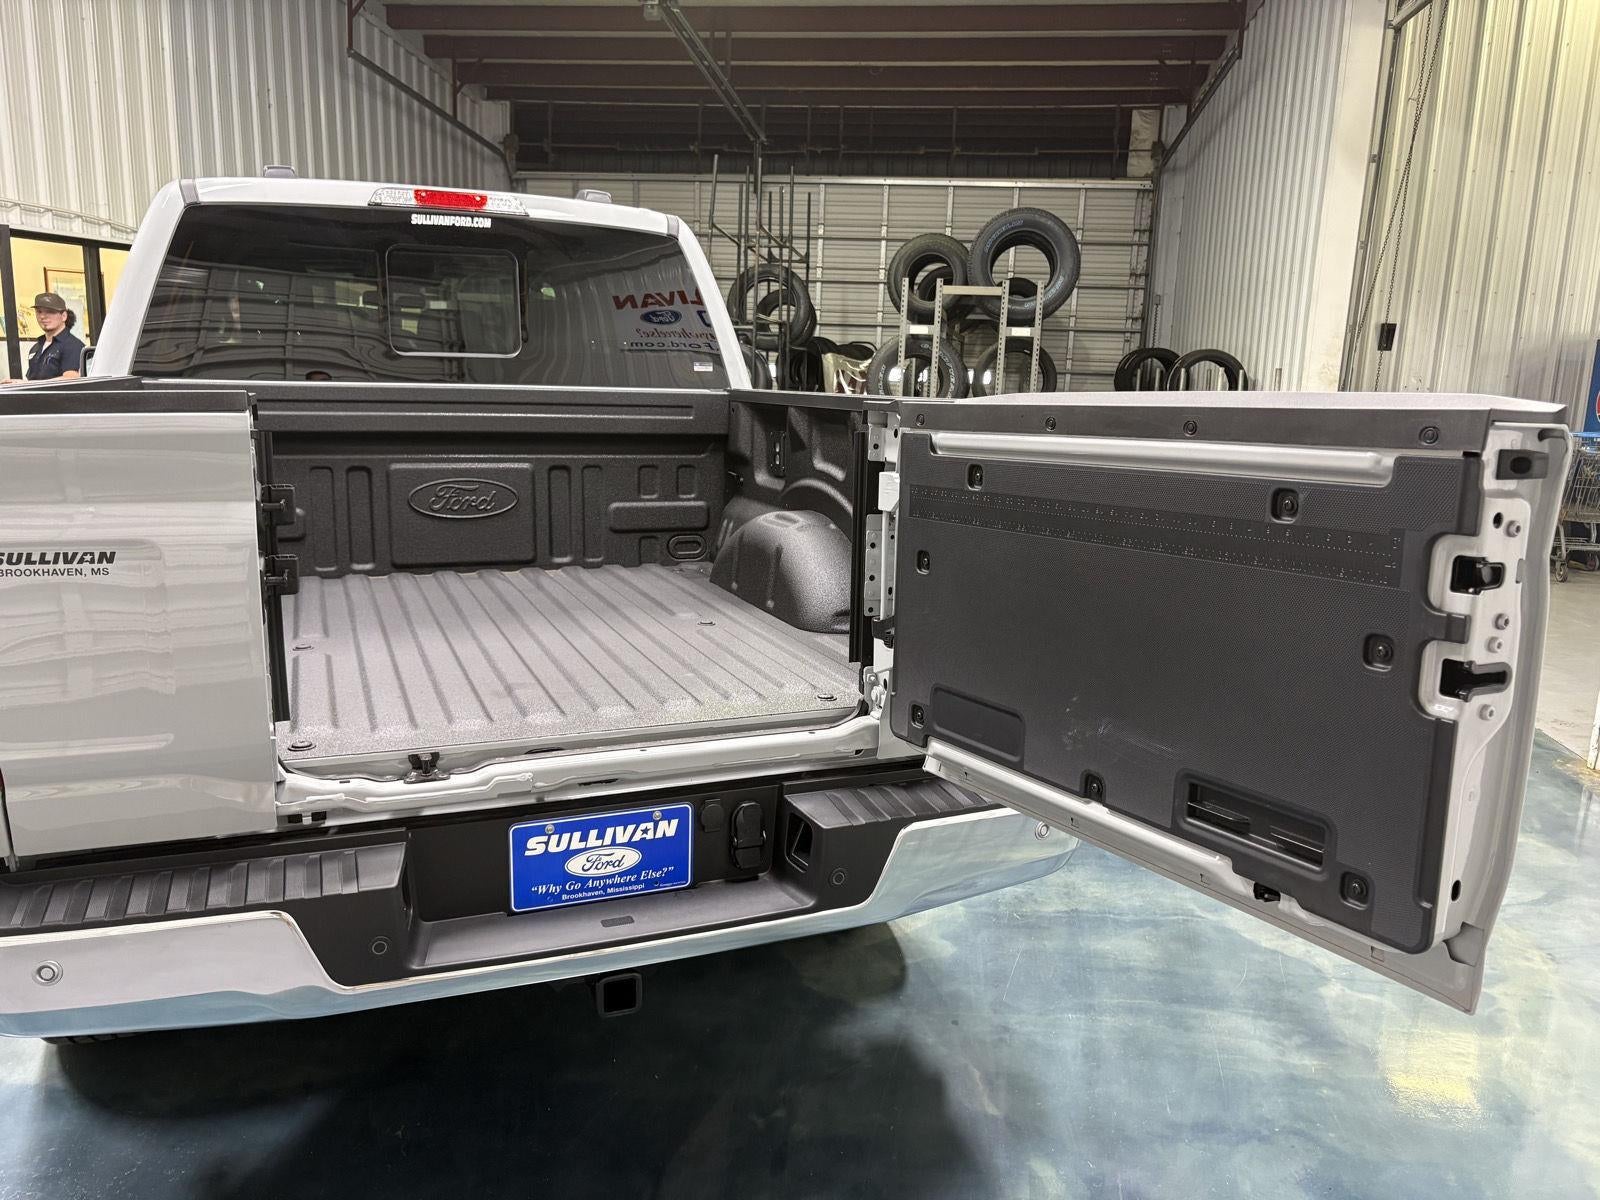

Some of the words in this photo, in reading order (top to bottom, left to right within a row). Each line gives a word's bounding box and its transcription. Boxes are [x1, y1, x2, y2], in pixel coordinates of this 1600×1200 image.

[411, 214, 491, 228] SULLIVANFORD.COM
[430, 484, 496, 510] Ford
[91, 567, 110, 576] MS
[524, 819, 679, 856] SULLIVAN
[581, 852, 626, 872] Ford
[565, 881, 581, 891] Go
[584, 874, 638, 889] Anywhere
[562, 890, 606, 901] Brookhaven,
[607, 883, 645, 893] Mississippi
